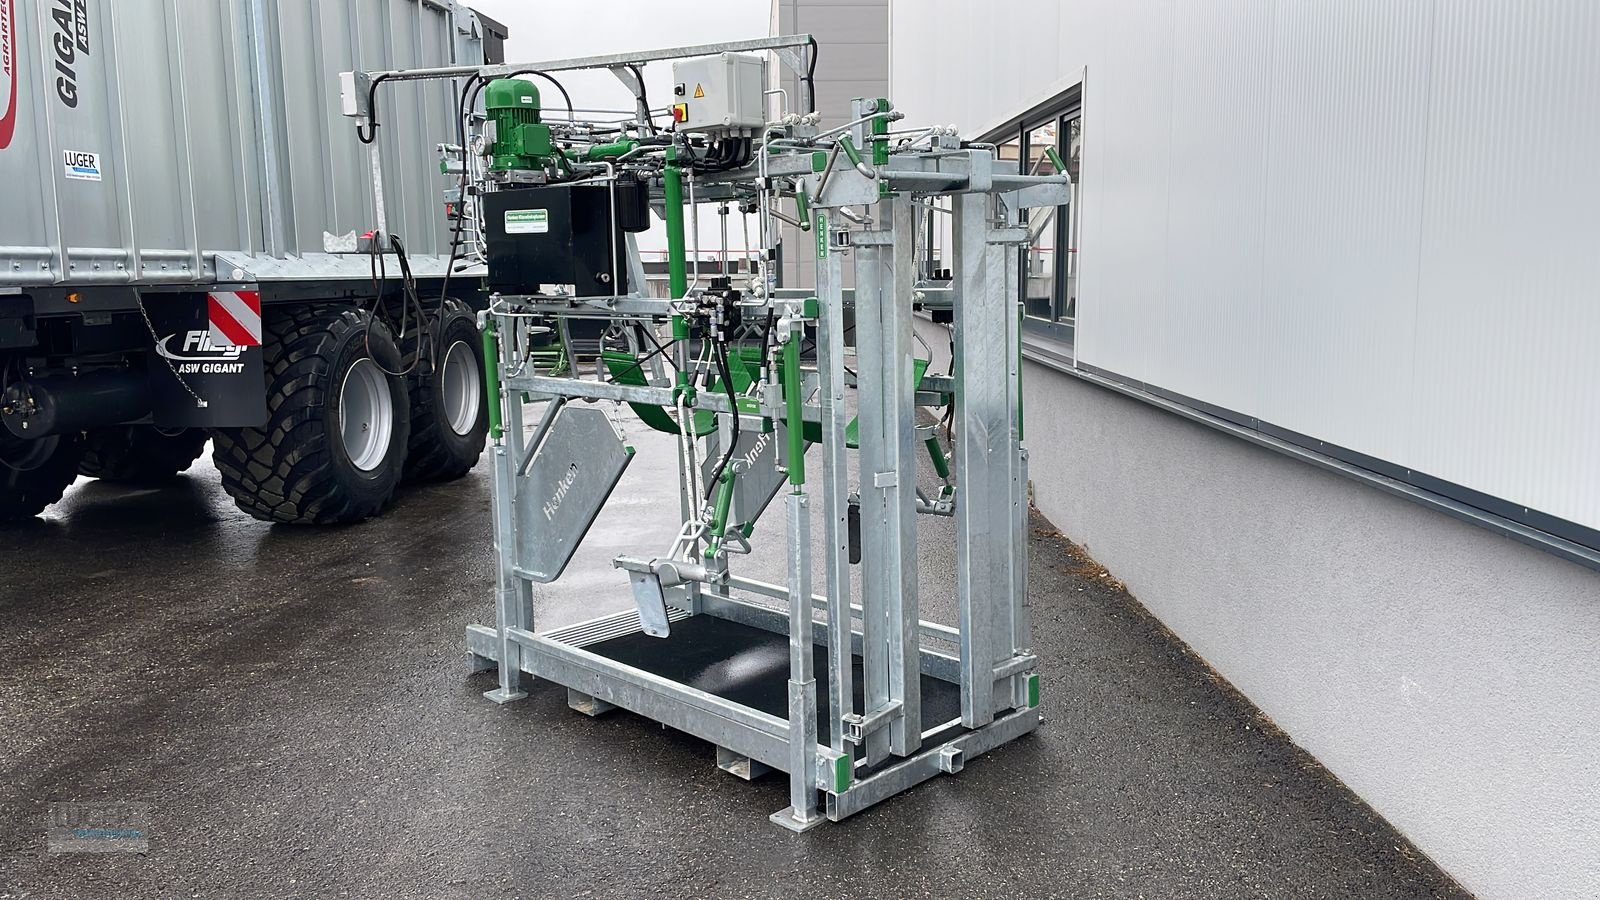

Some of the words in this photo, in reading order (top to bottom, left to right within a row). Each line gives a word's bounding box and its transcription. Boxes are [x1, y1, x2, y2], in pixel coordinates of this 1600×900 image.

[64, 151, 96, 168] LUGER
[178, 363, 200, 374] ASW
[202, 363, 244, 374] GIGANT
[543, 462, 578, 521] Henken
